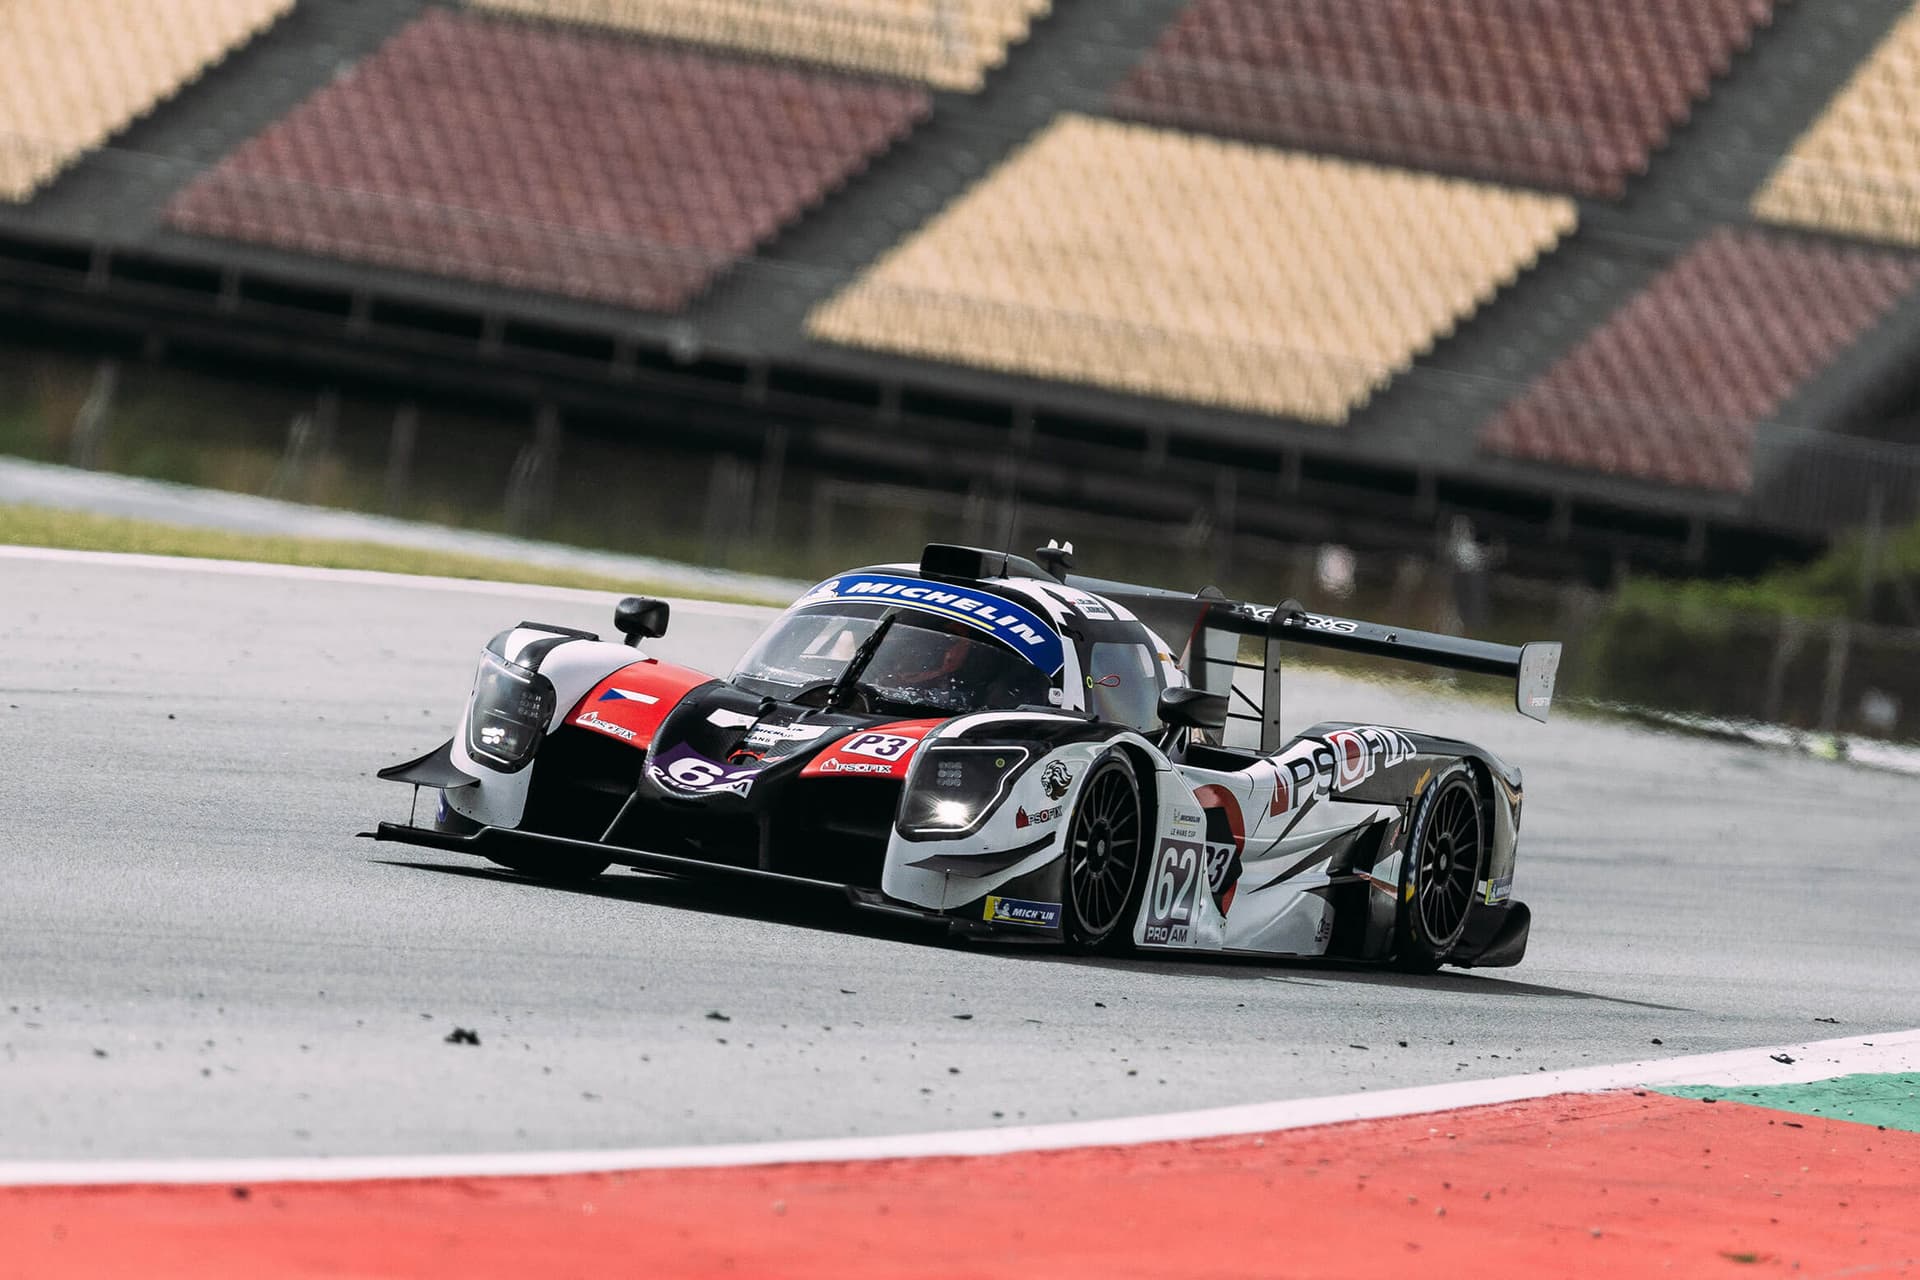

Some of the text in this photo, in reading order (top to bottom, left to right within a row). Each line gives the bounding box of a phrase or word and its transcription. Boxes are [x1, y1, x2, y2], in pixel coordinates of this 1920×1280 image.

[846, 581, 1045, 645] MICHELIN
[849, 734, 908, 757] P3
[837, 763, 893, 774] PSOFIX
[1028, 805, 1063, 826] PSOFIX
[1154, 846, 1197, 921] 62
[1012, 908, 1055, 921] MICHLIN
[1147, 925, 1188, 943] PRO AM
